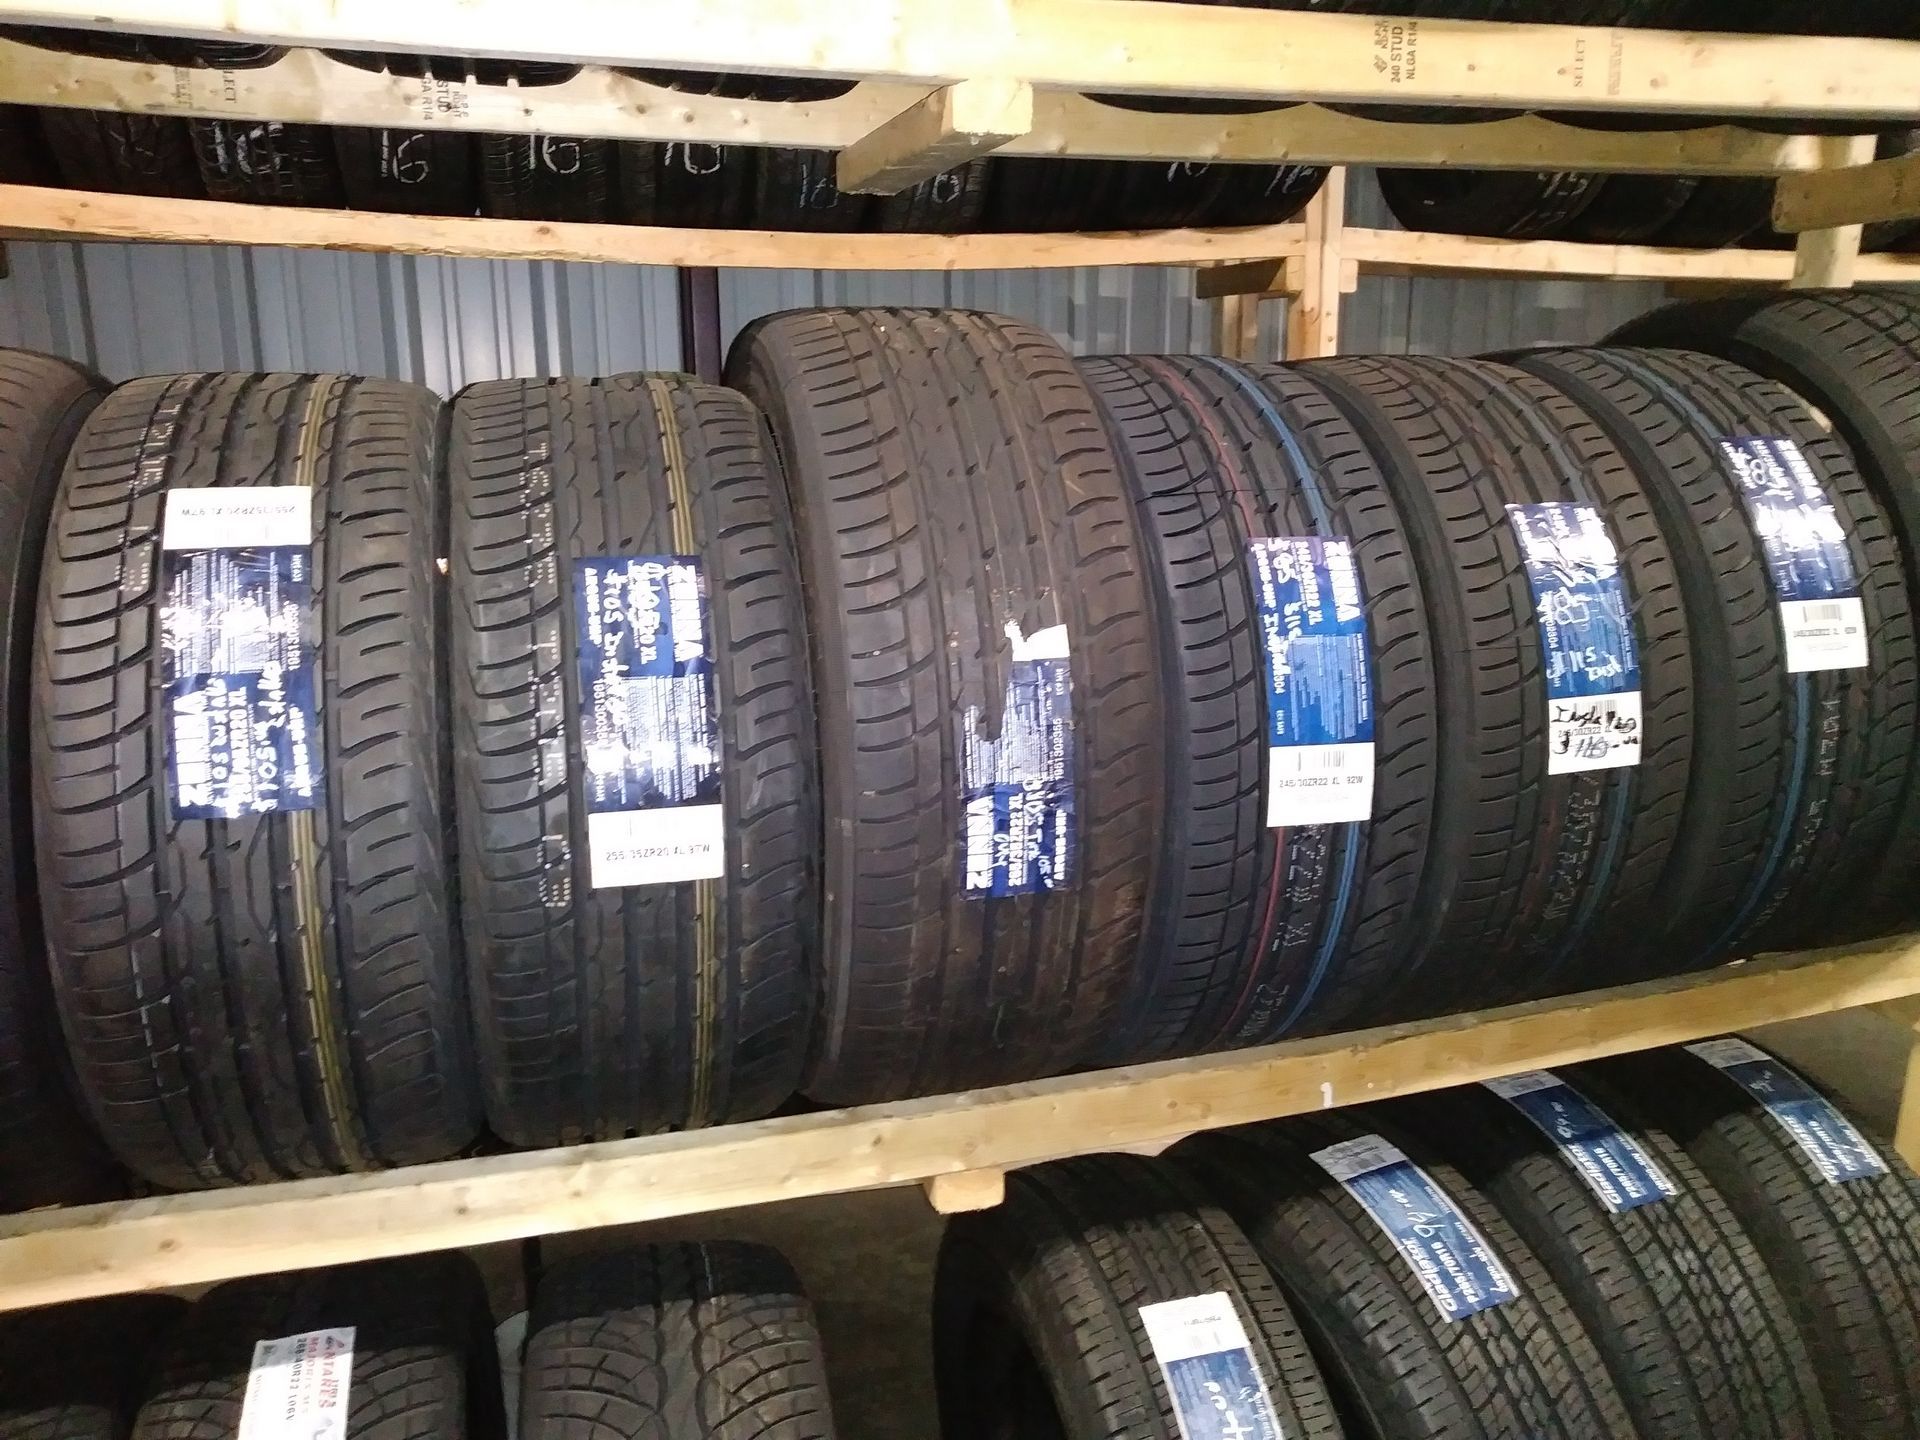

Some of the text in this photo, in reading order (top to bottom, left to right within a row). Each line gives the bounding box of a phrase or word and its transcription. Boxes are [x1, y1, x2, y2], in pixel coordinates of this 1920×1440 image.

[1391, 26, 1404, 84] 240 STUD
[1406, 50, 1417, 80] NLGA
[1573, 38, 1586, 88] SELECT
[436, 79, 452, 113] STUD
[380, 130, 430, 184] 16
[1322, 541, 1361, 622] ZENNA
[667, 564, 704, 663] ZENNA
[1308, 609, 1323, 625] XL
[640, 647, 657, 664] XL
[229, 687, 247, 707] XL
[173, 690, 211, 807] ZENNA
[1009, 792, 1024, 809] XL
[966, 796, 993, 889] ZENNA
[1054, 809, 1068, 880] ARGUS-UHP
[1566, 1142, 1624, 1206] Gladiator
[1401, 1236, 1459, 1313] Gladiator
